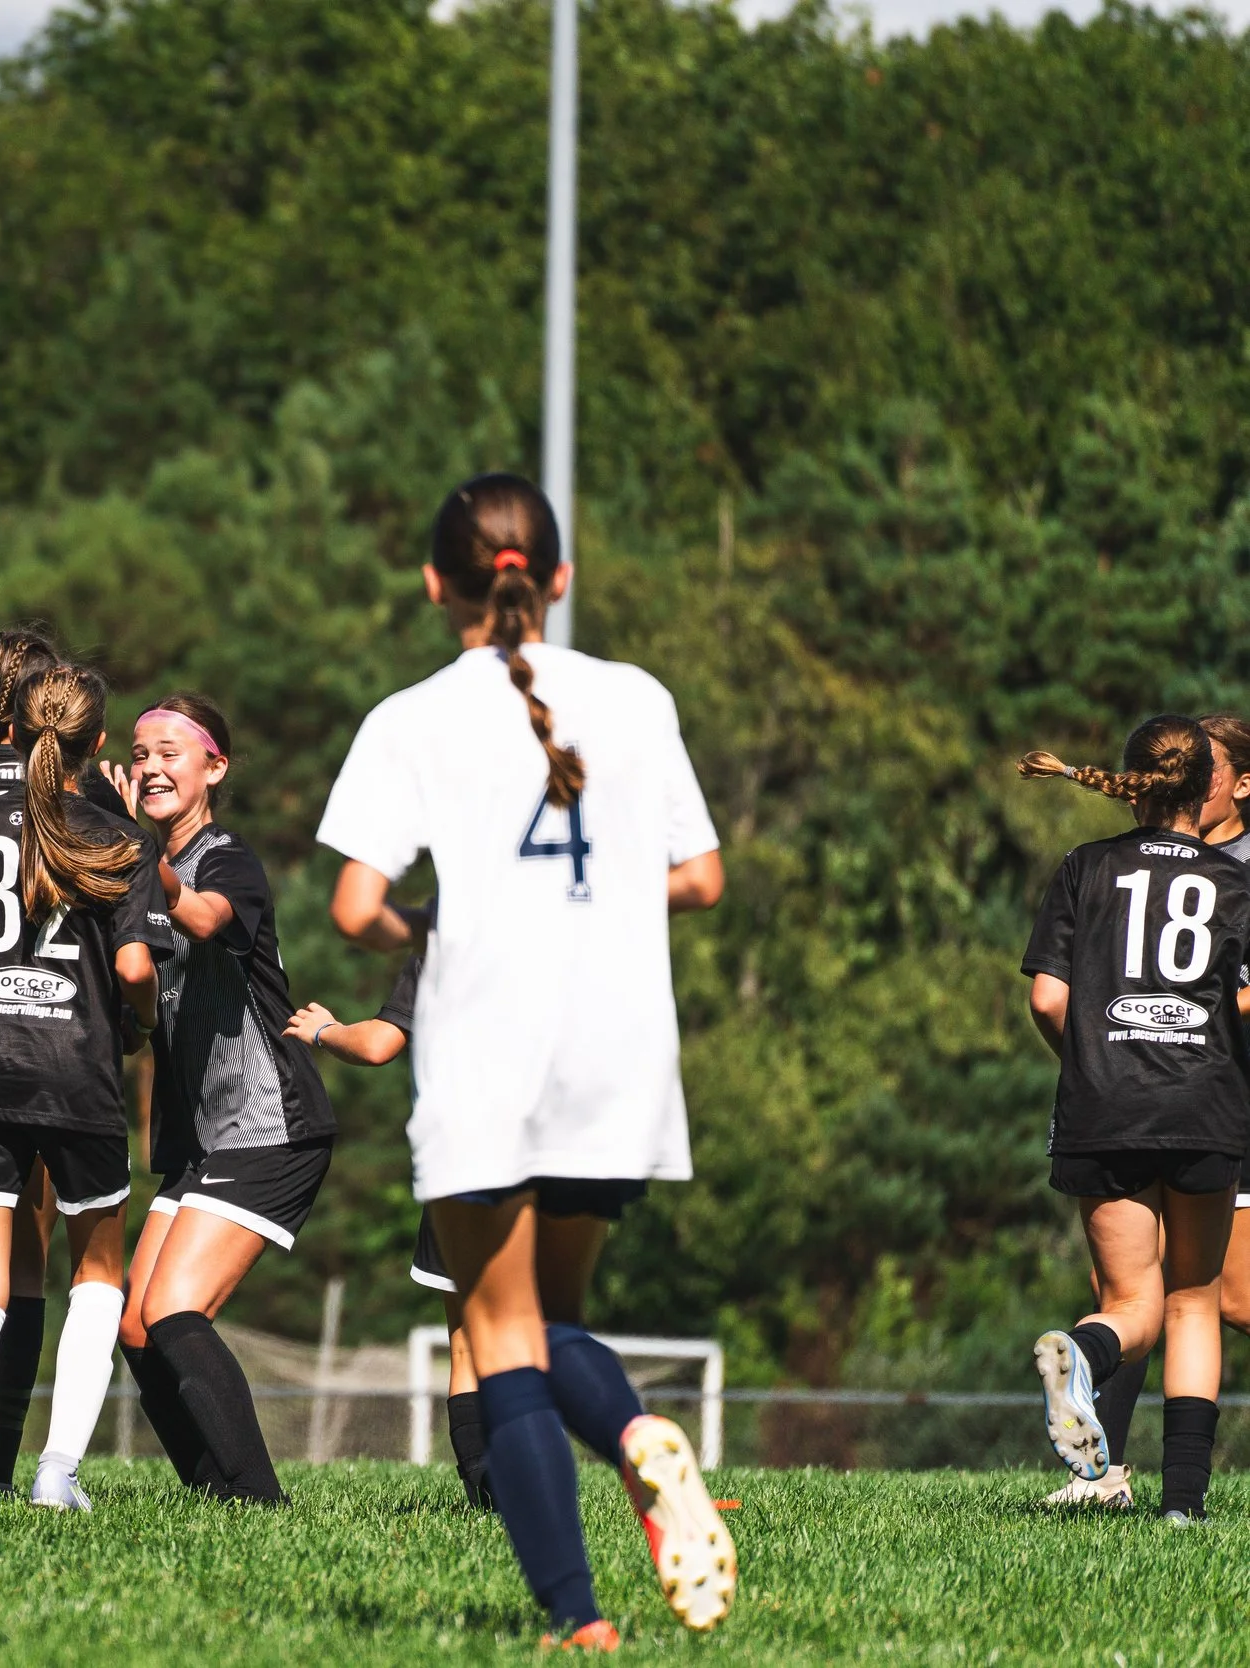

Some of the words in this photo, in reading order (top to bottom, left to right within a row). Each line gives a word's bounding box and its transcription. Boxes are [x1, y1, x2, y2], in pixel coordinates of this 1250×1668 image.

[517, 786, 592, 901] 4
[1116, 869, 1217, 983] 18
[17, 987, 54, 999] village
[1120, 1002, 1194, 1017] soccer
[1154, 1015, 1188, 1025] village
[1108, 1029, 1206, 1045] www.soccervillage.com
